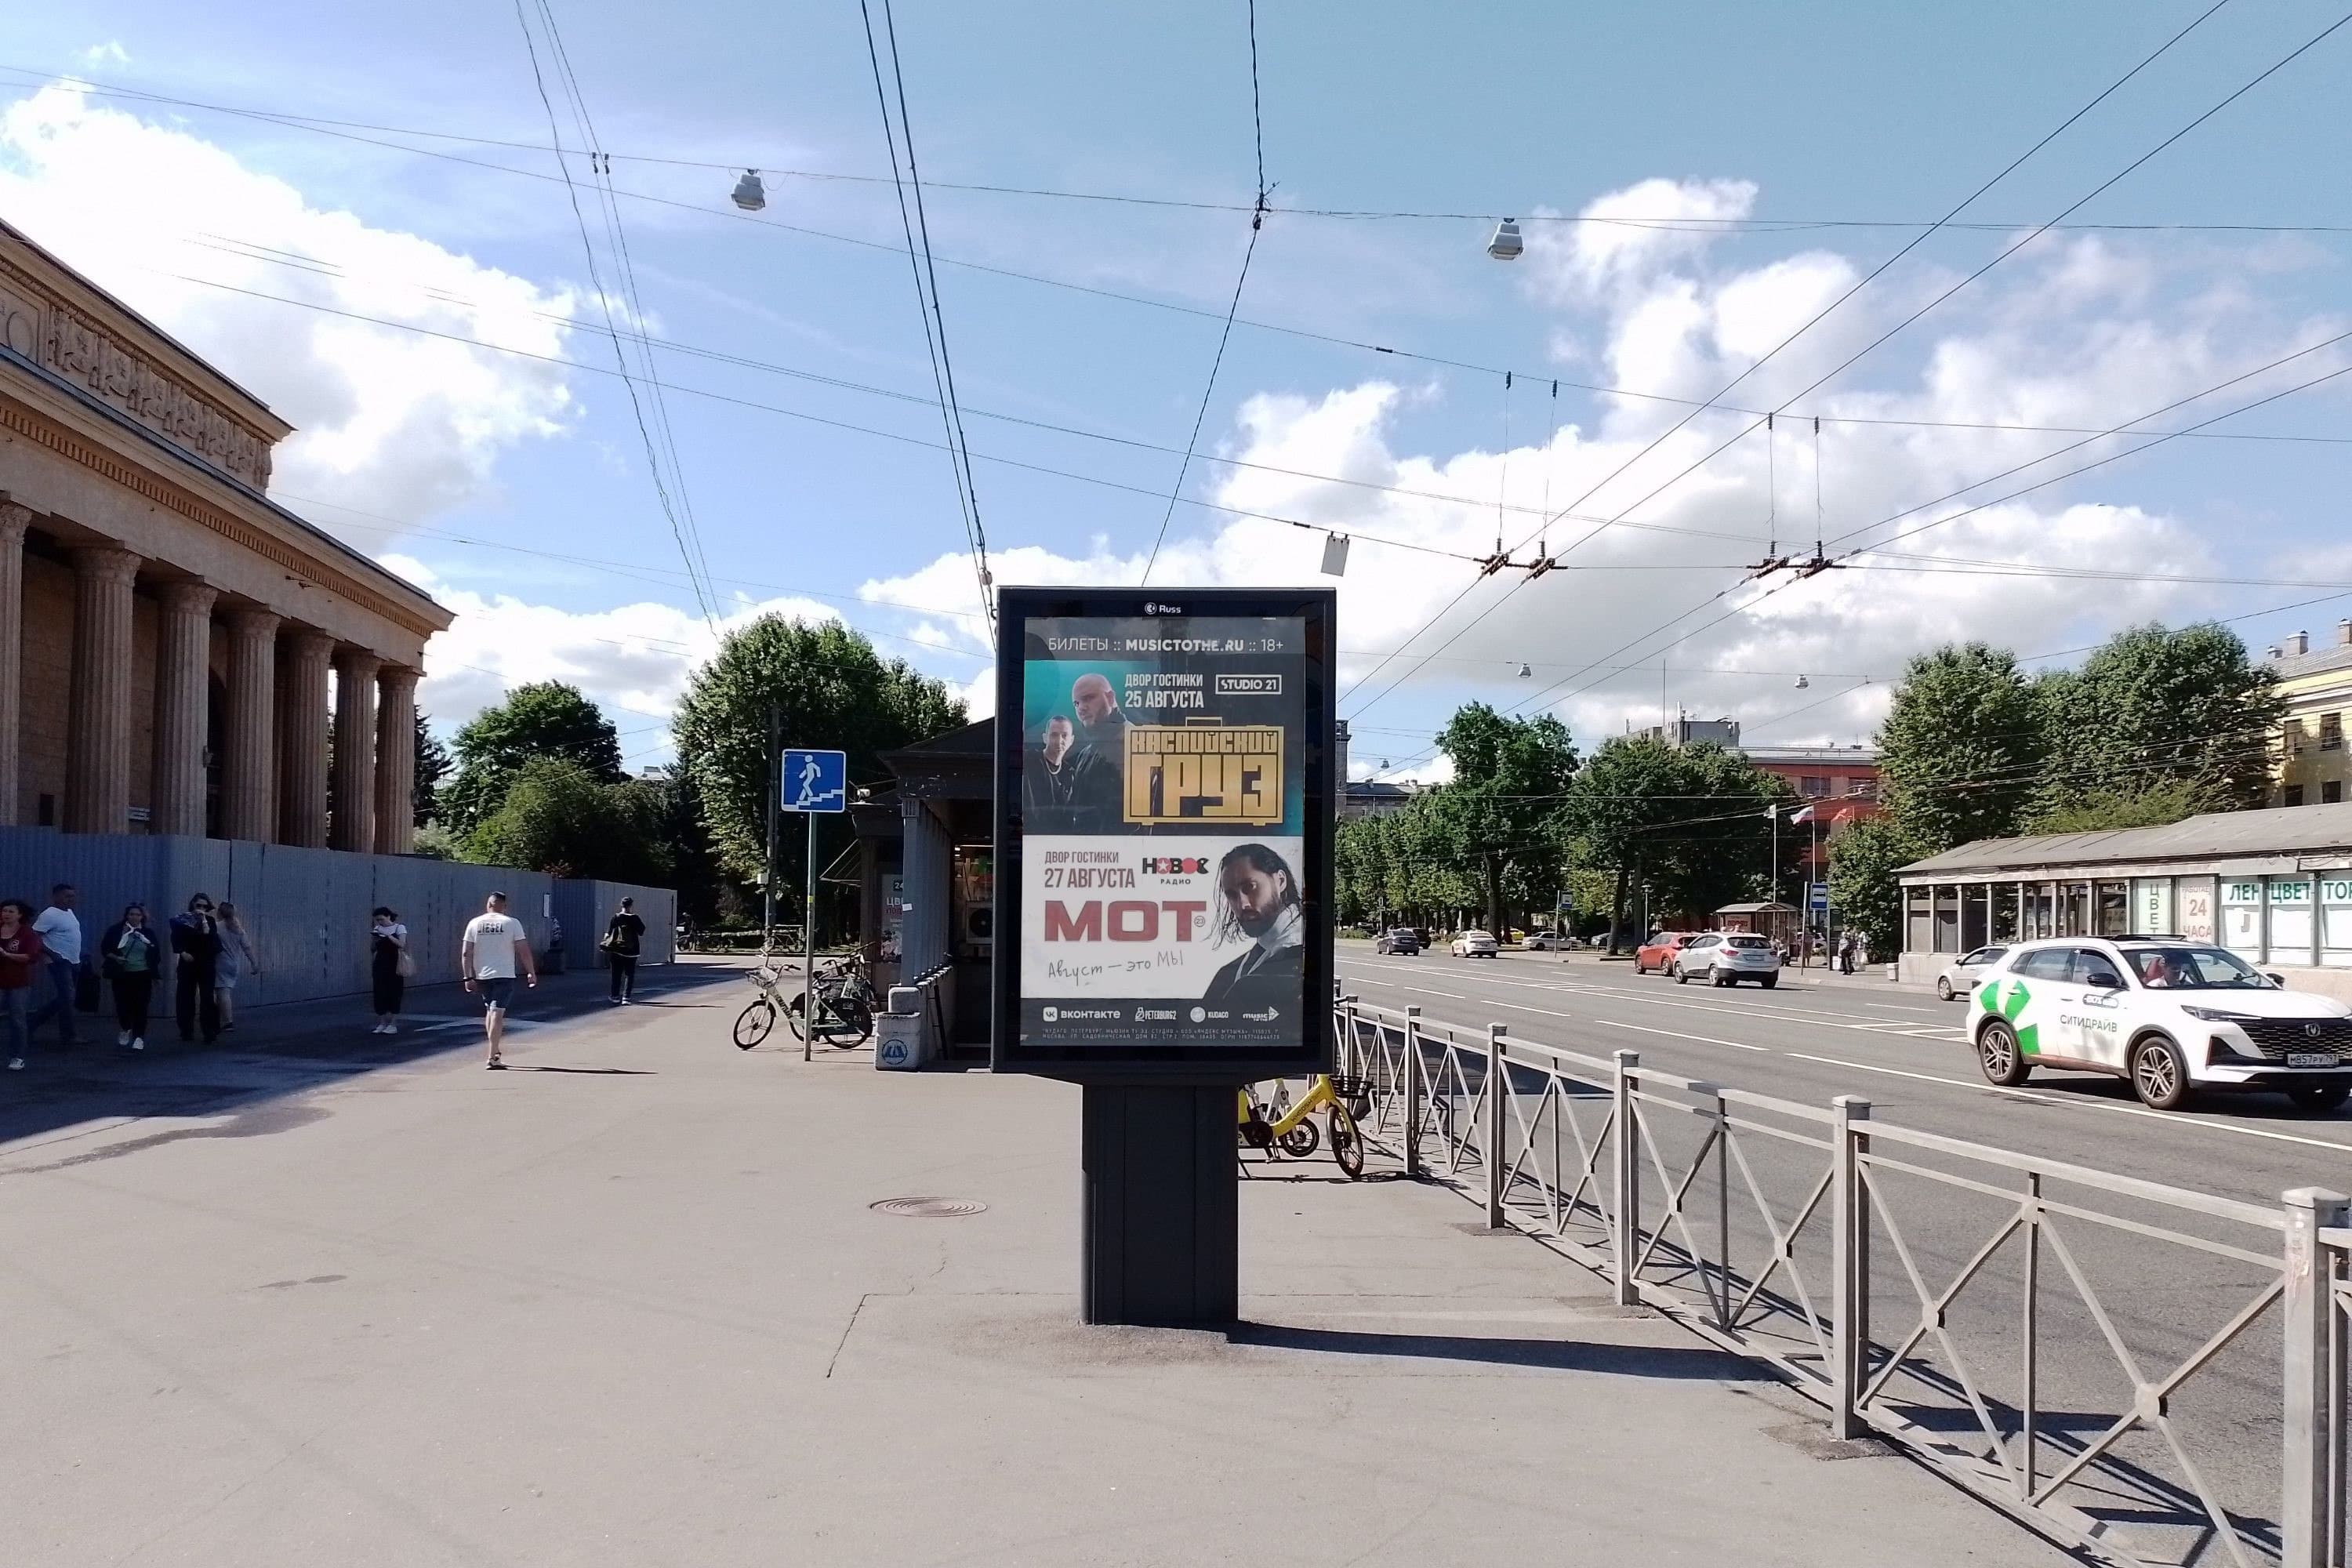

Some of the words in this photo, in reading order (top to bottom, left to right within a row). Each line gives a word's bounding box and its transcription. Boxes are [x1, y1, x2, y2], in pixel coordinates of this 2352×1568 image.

[1159, 604, 1181, 614] Russ
[1048, 637, 1109, 651] БИЛЕТЫ
[1126, 639, 1244, 652] MUSICTOTHE.RU
[1261, 638, 1283, 652] 18+
[1124, 673, 1152, 688] ДВОР
[1153, 673, 1203, 687] ГОСТИНКИ
[1221, 679, 1263, 690] STUDIO
[1265, 679, 1277, 690] 21
[1125, 691, 1142, 708] 25
[1145, 690, 1204, 708] АВГУСТА
[1131, 731, 1278, 753] КАСПИЙСКИЙ
[1131, 754, 1277, 816] ГРУЗ
[1045, 851, 1069, 864] ДВОР
[1072, 851, 1119, 863] ГОСТИНКИ
[1044, 868, 1064, 888] 27
[1067, 868, 1135, 888] АВГУСТА
[2189, 898, 2207, 916] 24
[1044, 900, 1207, 942] МОТ
[2183, 925, 2212, 938] ЧАСА
[1048, 959, 1103, 986] Август
[1126, 960, 1152, 971] это
[1156, 949, 1184, 967] МЫ
[1061, 1010, 1121, 1019] вконтакте
[2060, 1014, 2118, 1033] СИТИДРАЙВ
